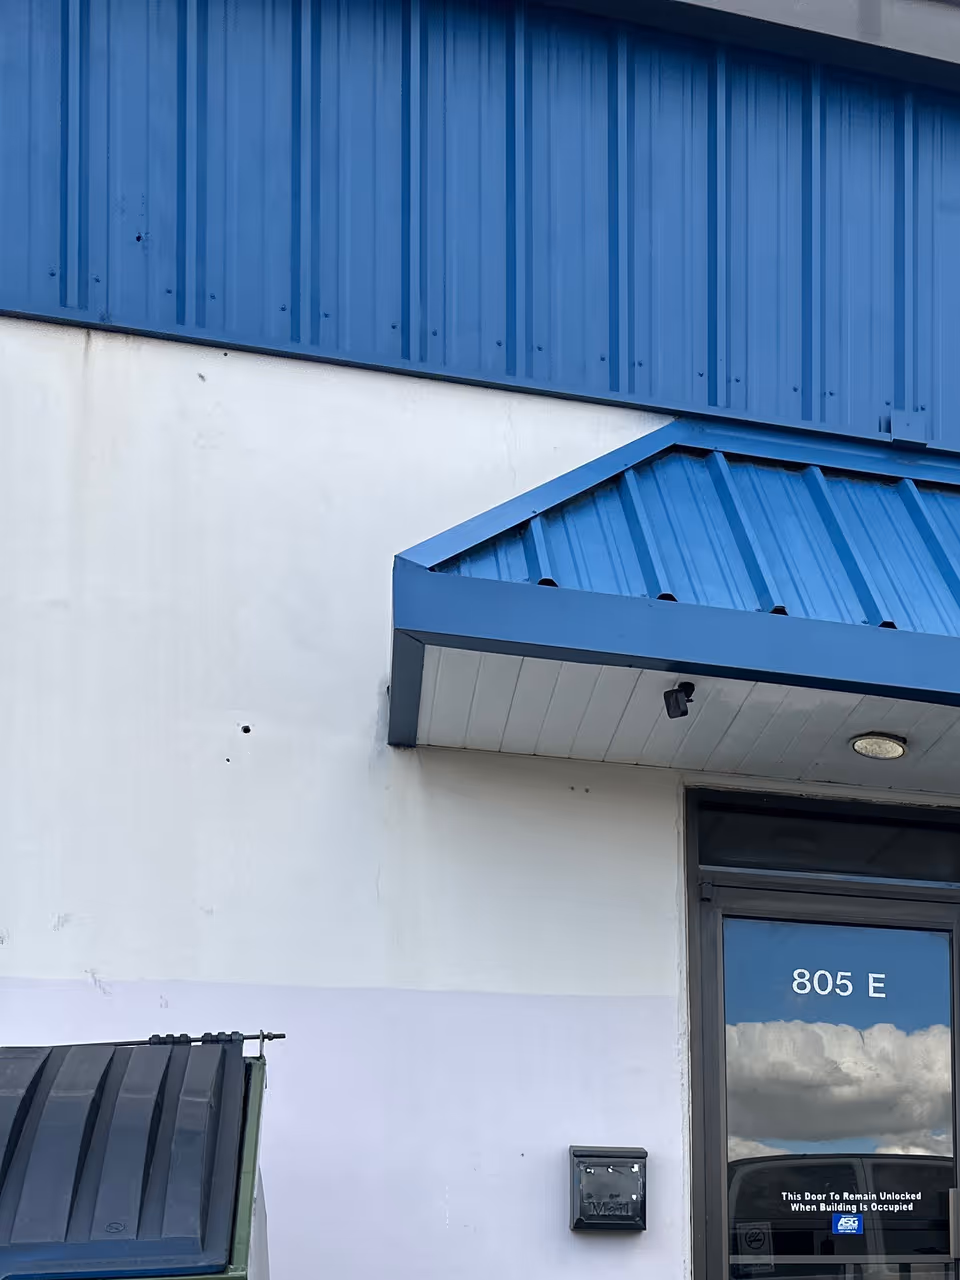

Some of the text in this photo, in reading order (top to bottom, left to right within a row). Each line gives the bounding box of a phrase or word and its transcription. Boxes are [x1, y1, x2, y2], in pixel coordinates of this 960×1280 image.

[792, 968, 886, 998] 805 E
[781, 1191, 922, 1201] This Door To Remain Unlocked
[588, 1201, 632, 1216] Mail
[791, 1202, 914, 1213] When Building Is Occupied
